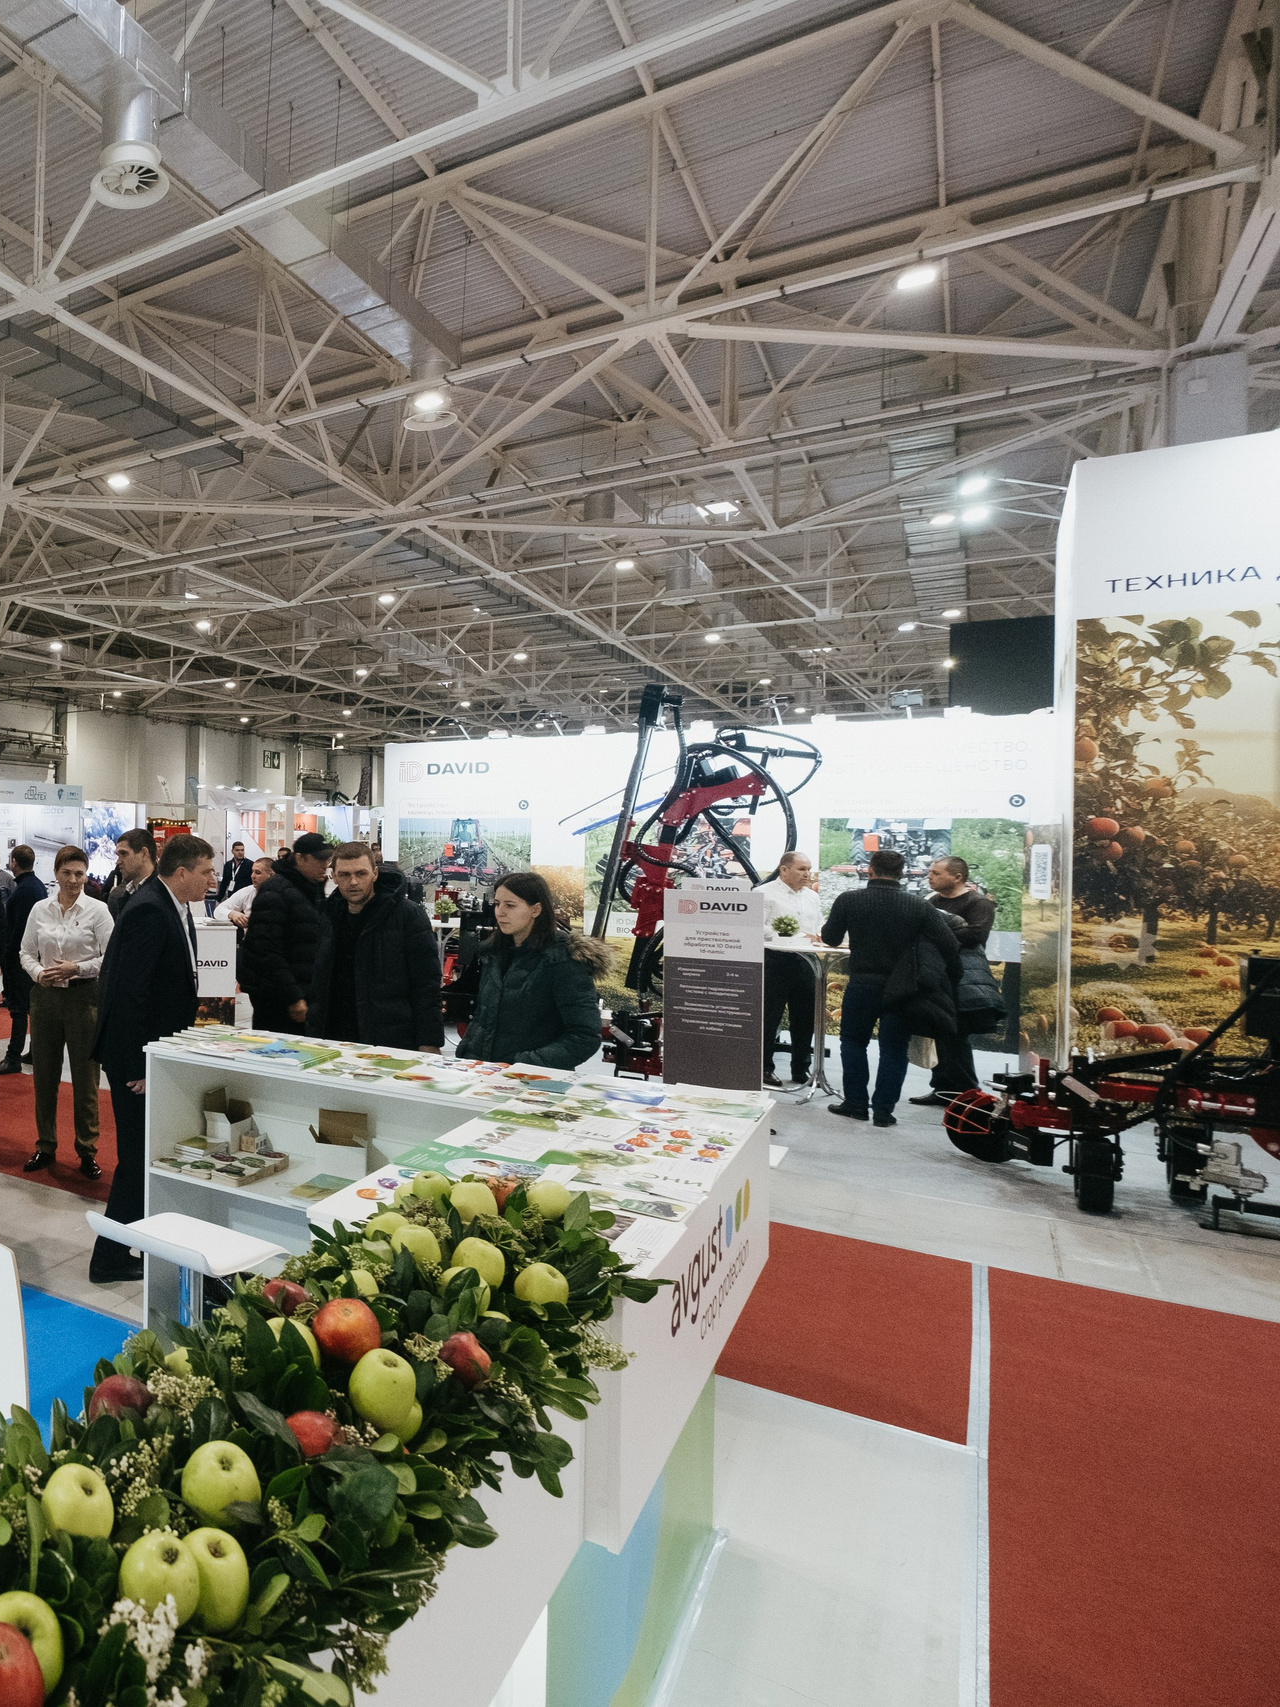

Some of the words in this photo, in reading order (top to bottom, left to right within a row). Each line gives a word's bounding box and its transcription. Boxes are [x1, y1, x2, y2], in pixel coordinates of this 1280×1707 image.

[1104, 566, 1261, 593] ТЕХНИКА
[427, 762, 489, 775] DAVID
[700, 902, 748, 912] DAVID
[671, 1204, 723, 1338] avgust
